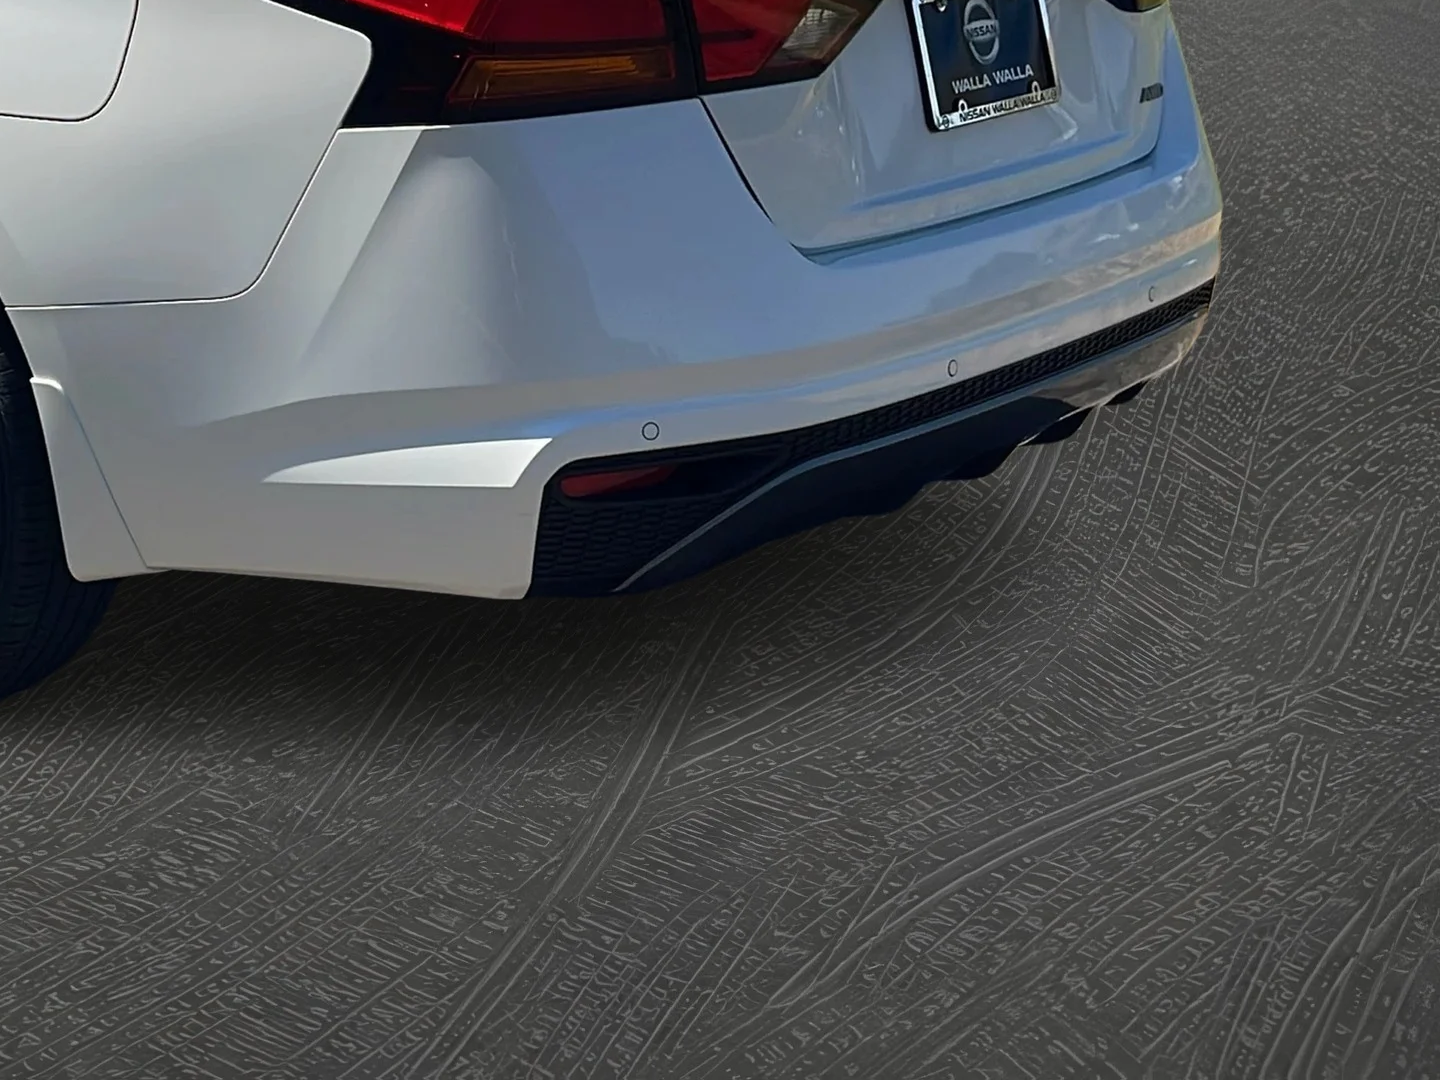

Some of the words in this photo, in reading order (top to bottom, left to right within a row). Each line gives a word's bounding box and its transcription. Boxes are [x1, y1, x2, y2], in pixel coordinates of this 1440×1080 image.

[966, 24, 996, 38] NISSAN
[952, 73, 991, 94] WALLA
[992, 64, 1034, 84] WALLA
[959, 107, 991, 122] NISSAN
[992, 100, 1018, 114] WALLA
